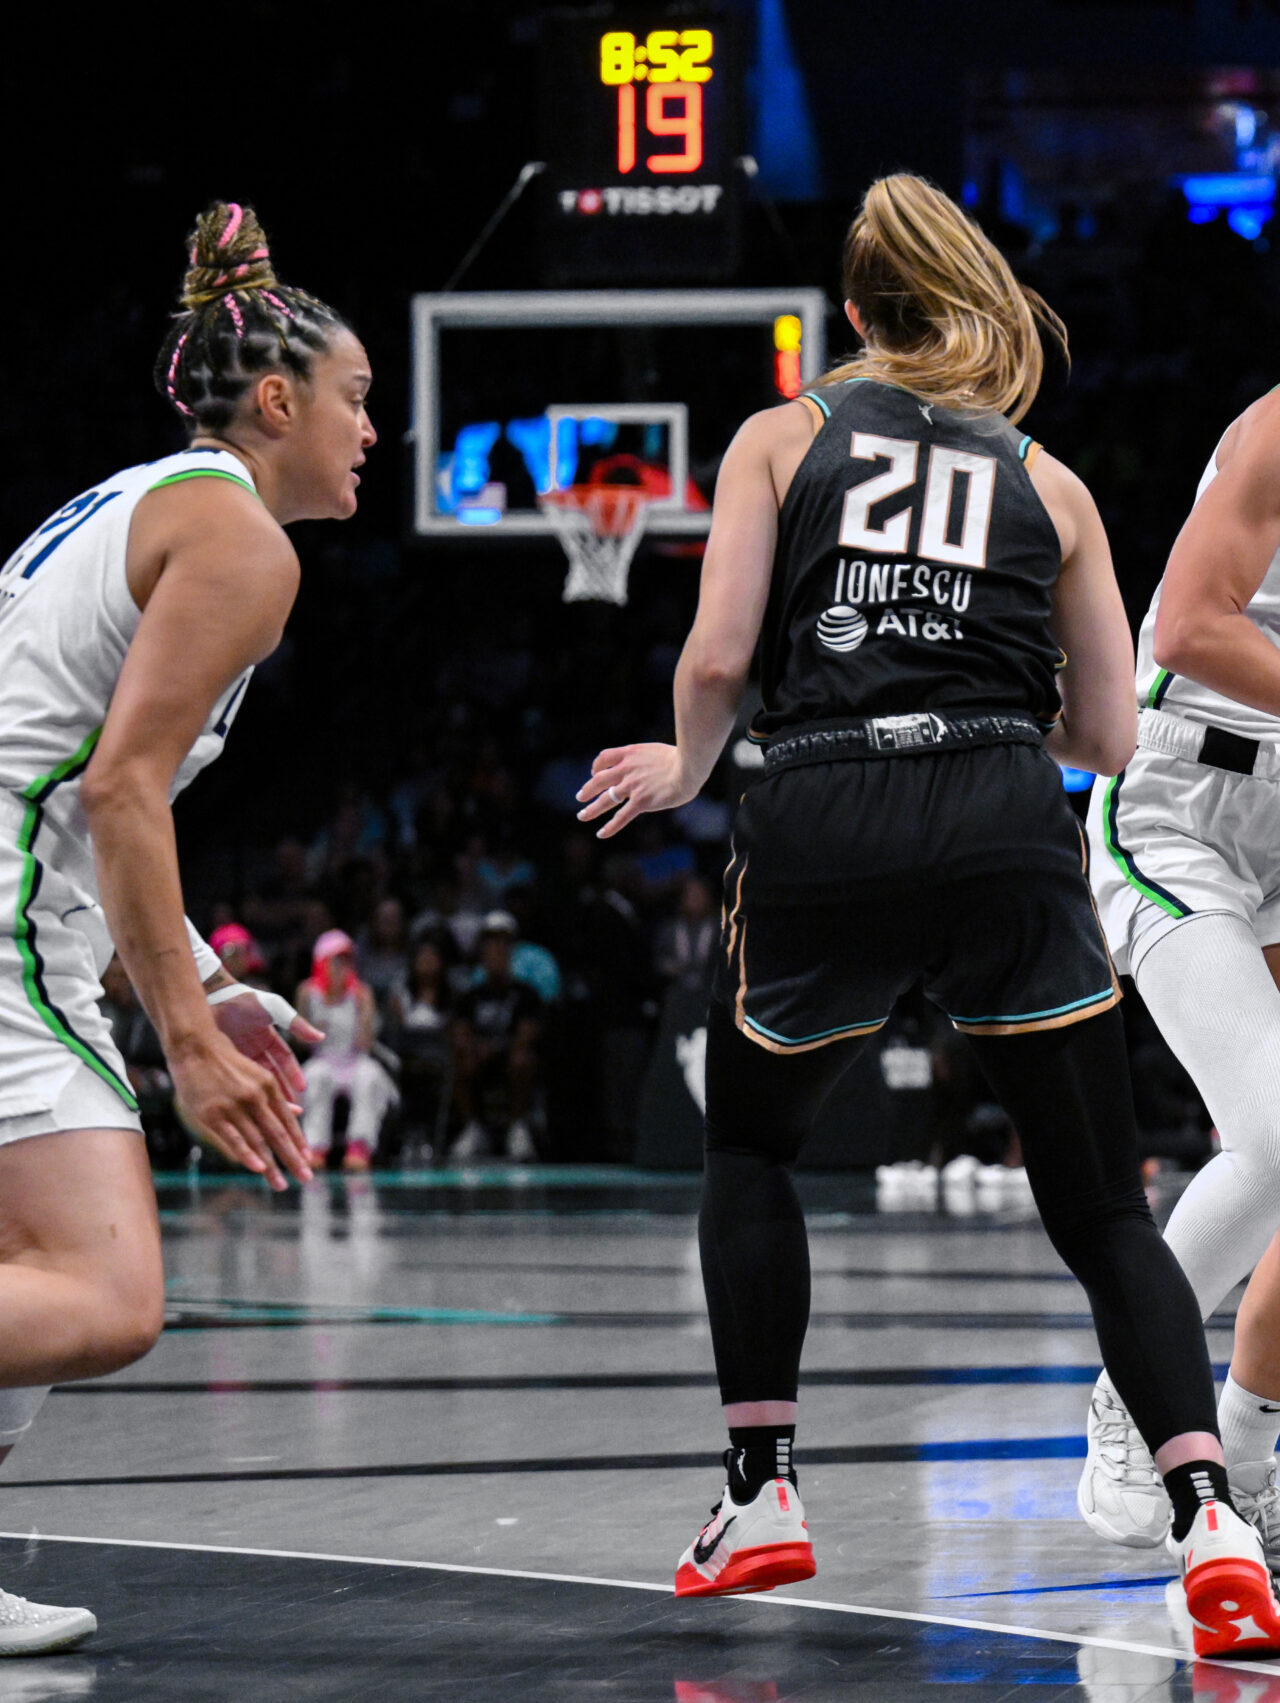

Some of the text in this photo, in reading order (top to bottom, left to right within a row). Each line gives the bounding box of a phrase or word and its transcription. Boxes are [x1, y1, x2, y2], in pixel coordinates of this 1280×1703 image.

[601, 30, 714, 85] 8:52
[617, 81, 703, 174] 19
[603, 184, 723, 216] TISSOT
[838, 431, 998, 570] 20
[834, 558, 973, 612] IONESCU
